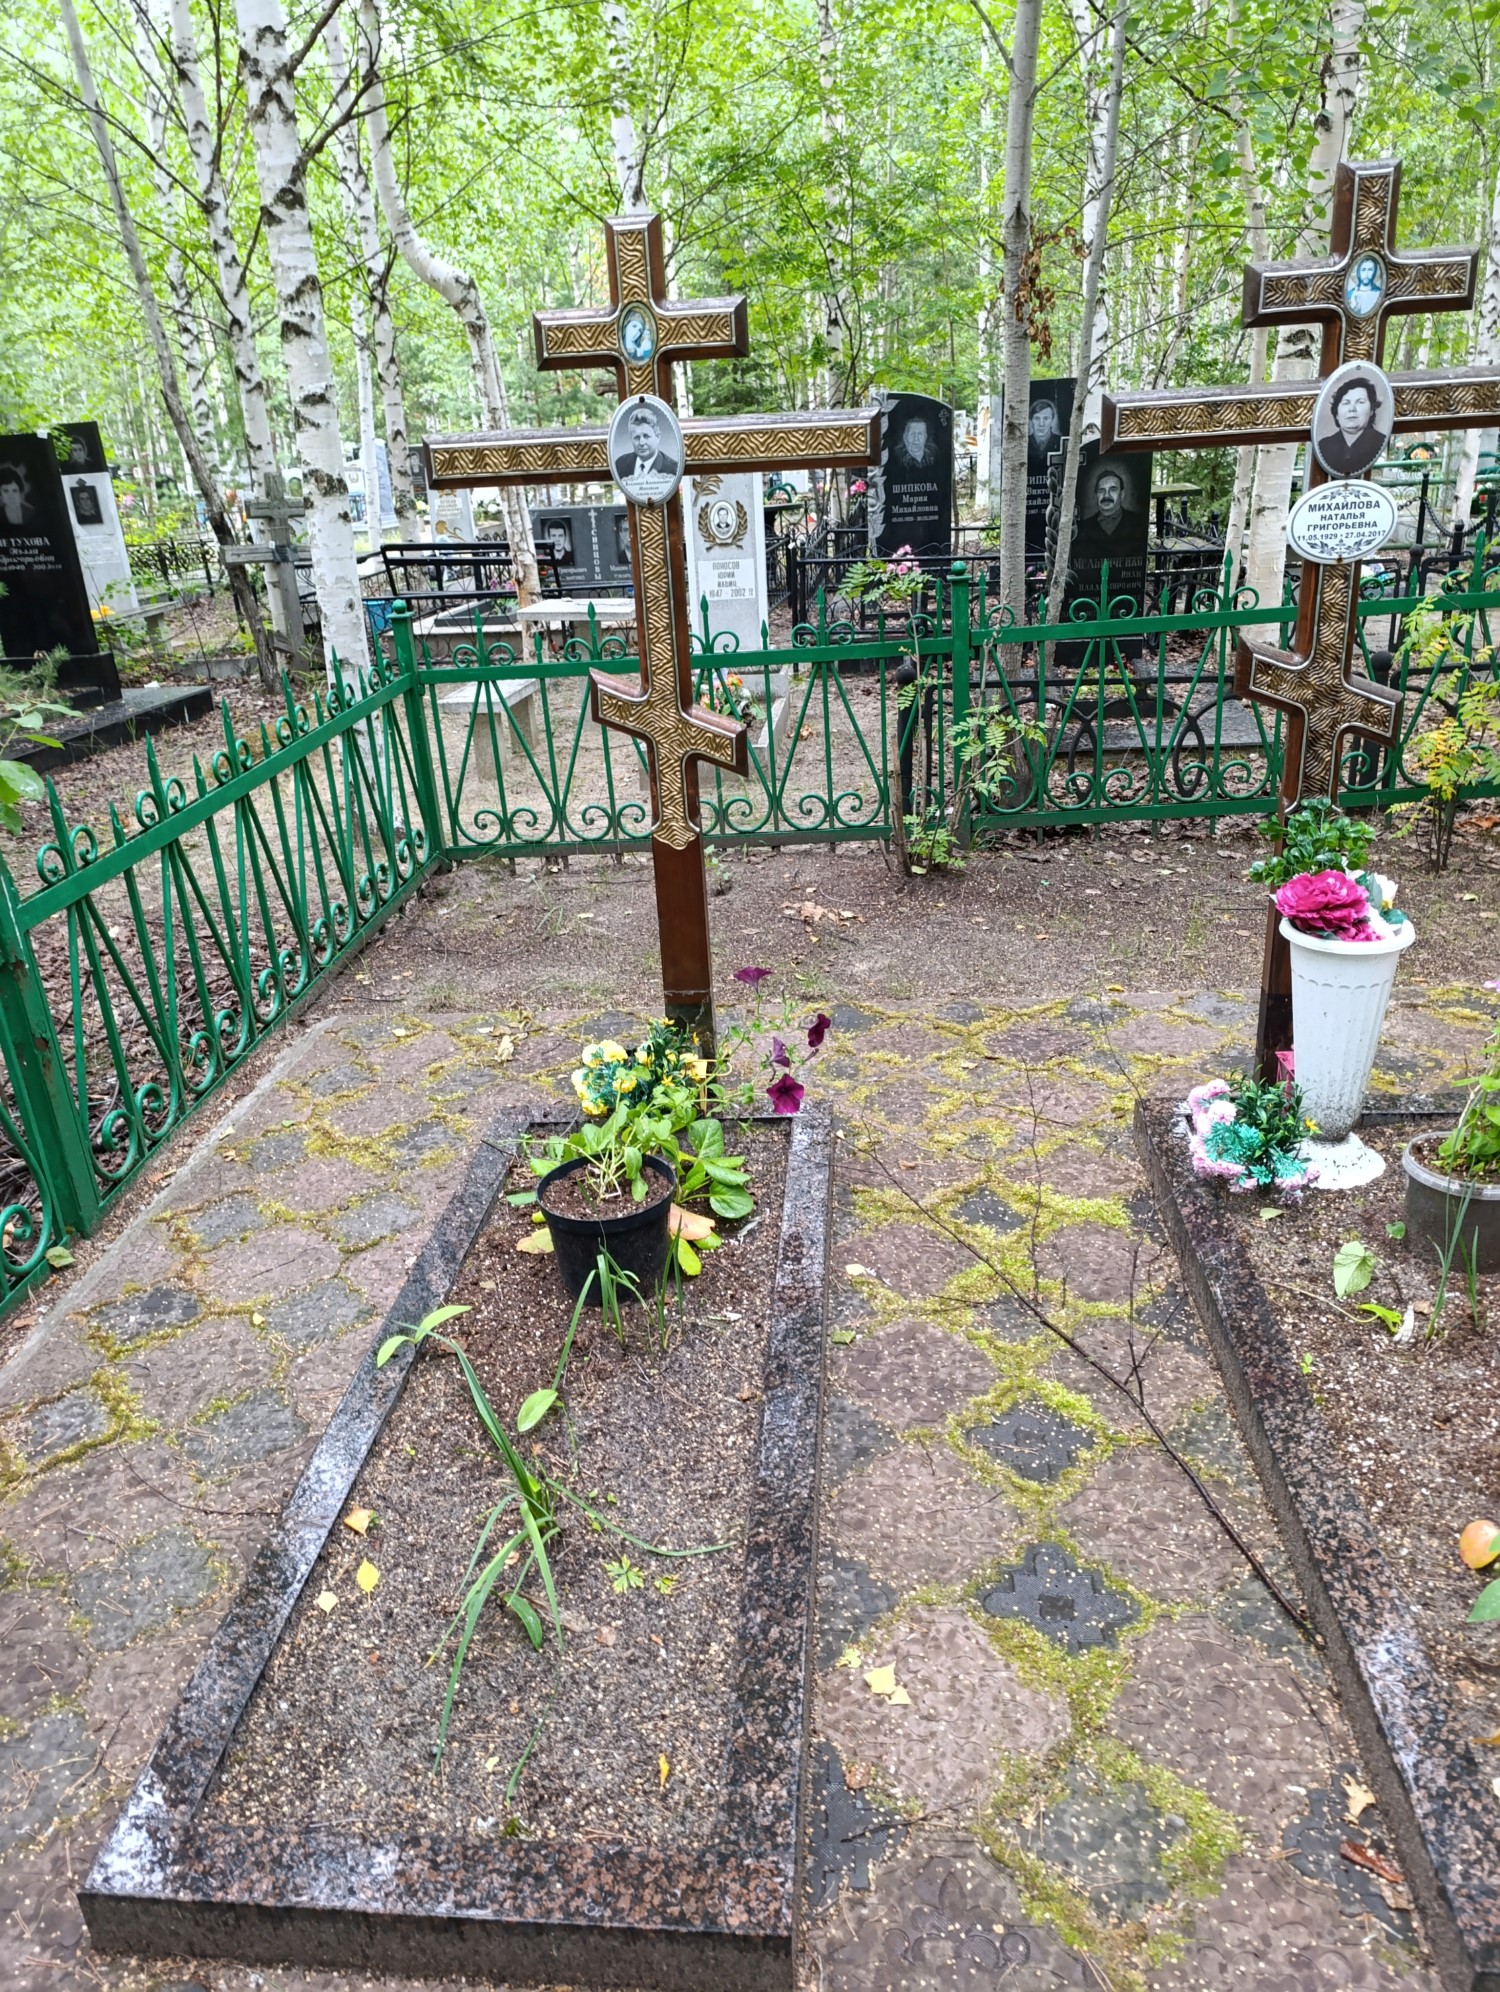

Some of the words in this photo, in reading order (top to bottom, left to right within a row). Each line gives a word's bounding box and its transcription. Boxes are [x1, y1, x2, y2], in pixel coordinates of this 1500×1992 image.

[892, 482, 938, 494] ШИПКОВА
[1320, 512, 1365, 521] НАТАЛЬЯ
[1307, 521, 1378, 532] ГРИГОРЬЕВНА
[1297, 532, 1338, 542] 11.05.1929
[1344, 530, 1386, 540] 27.04.2017
